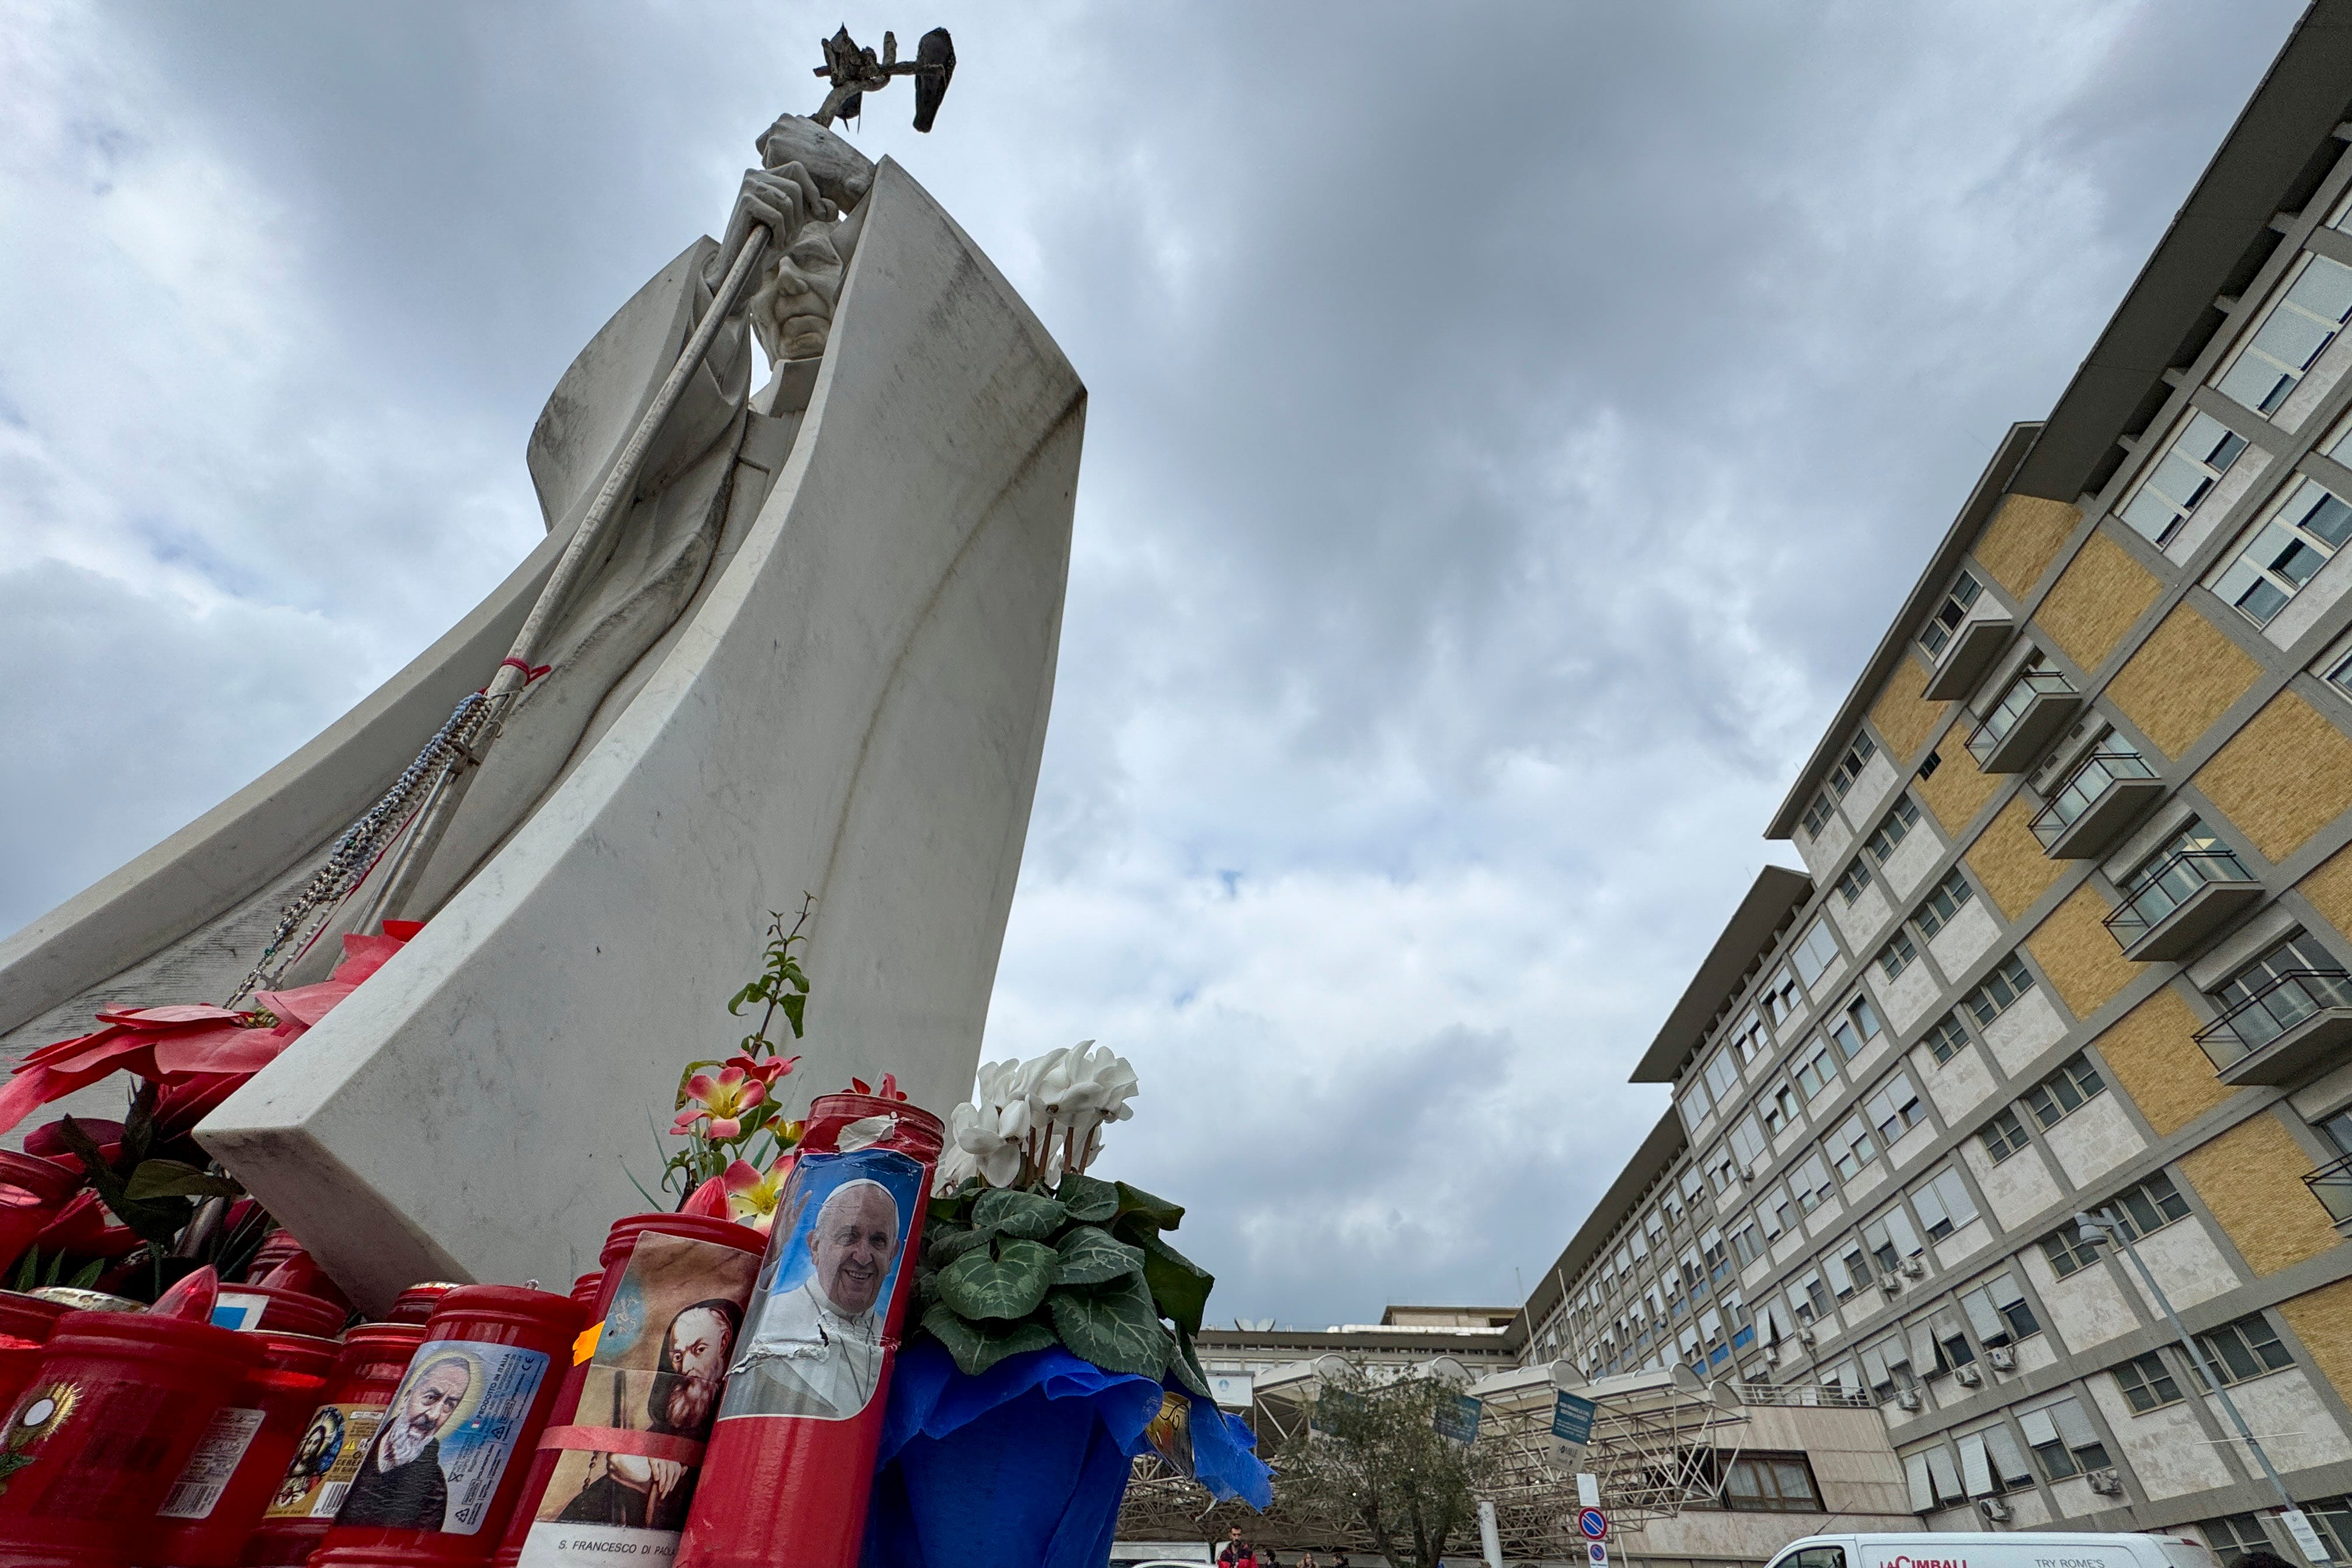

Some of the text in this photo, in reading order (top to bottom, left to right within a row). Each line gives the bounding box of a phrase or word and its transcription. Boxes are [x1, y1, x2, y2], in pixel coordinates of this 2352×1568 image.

[476, 1382, 496, 1419] PRODOTTO
[497, 1354, 511, 1372] ITALIA
[558, 1540, 676, 1556] S. FRANCESCO DI PAOLA
[2034, 1559, 2104, 1568] TRY ROME'S
